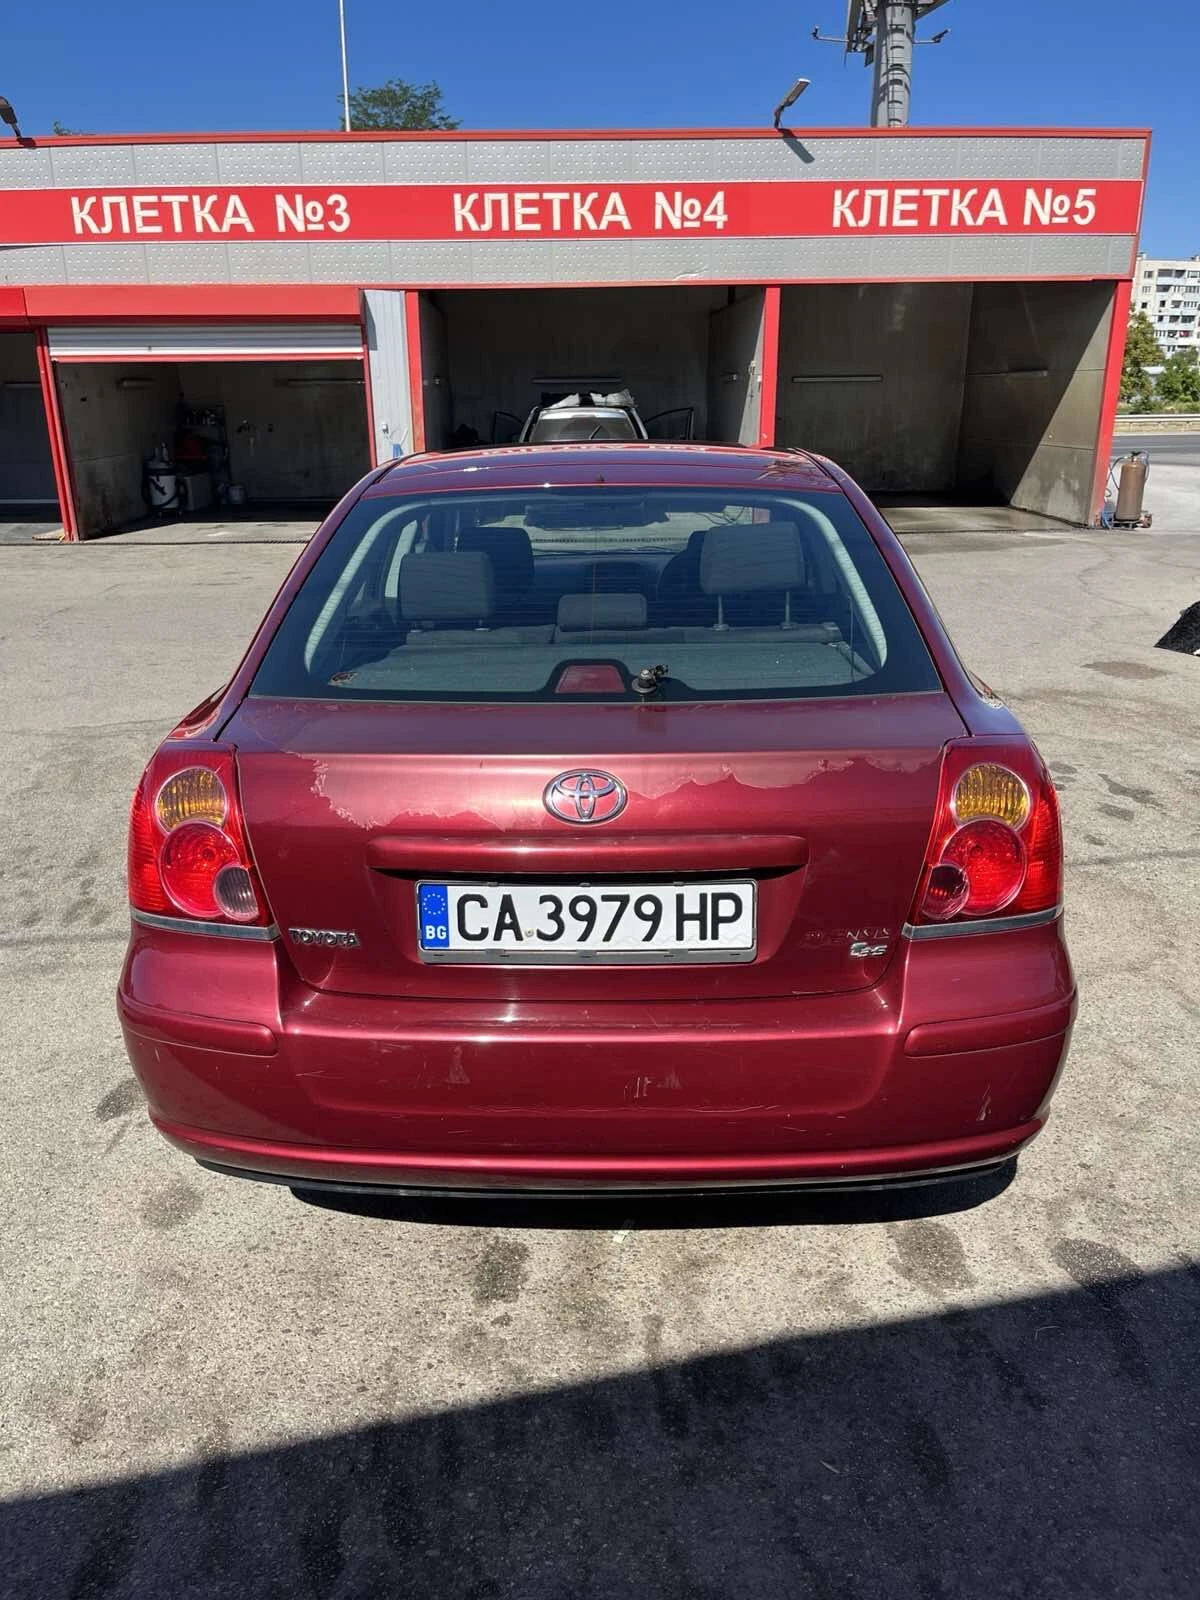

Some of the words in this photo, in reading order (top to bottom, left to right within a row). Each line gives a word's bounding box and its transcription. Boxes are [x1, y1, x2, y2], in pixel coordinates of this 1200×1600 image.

[71, 194, 254, 235] КЛЕТКА
[275, 193, 351, 233] №3
[453, 191, 632, 232] КЛЕТКА
[654, 190, 729, 230] №4
[832, 188, 1009, 228] КЛЕТКА
[1023, 187, 1097, 226] №5
[288, 927, 360, 947] TOYOTA
[425, 925, 447, 940] BG
[456, 894, 524, 941] CA
[537, 894, 664, 942] 3979
[676, 892, 743, 941] HP
